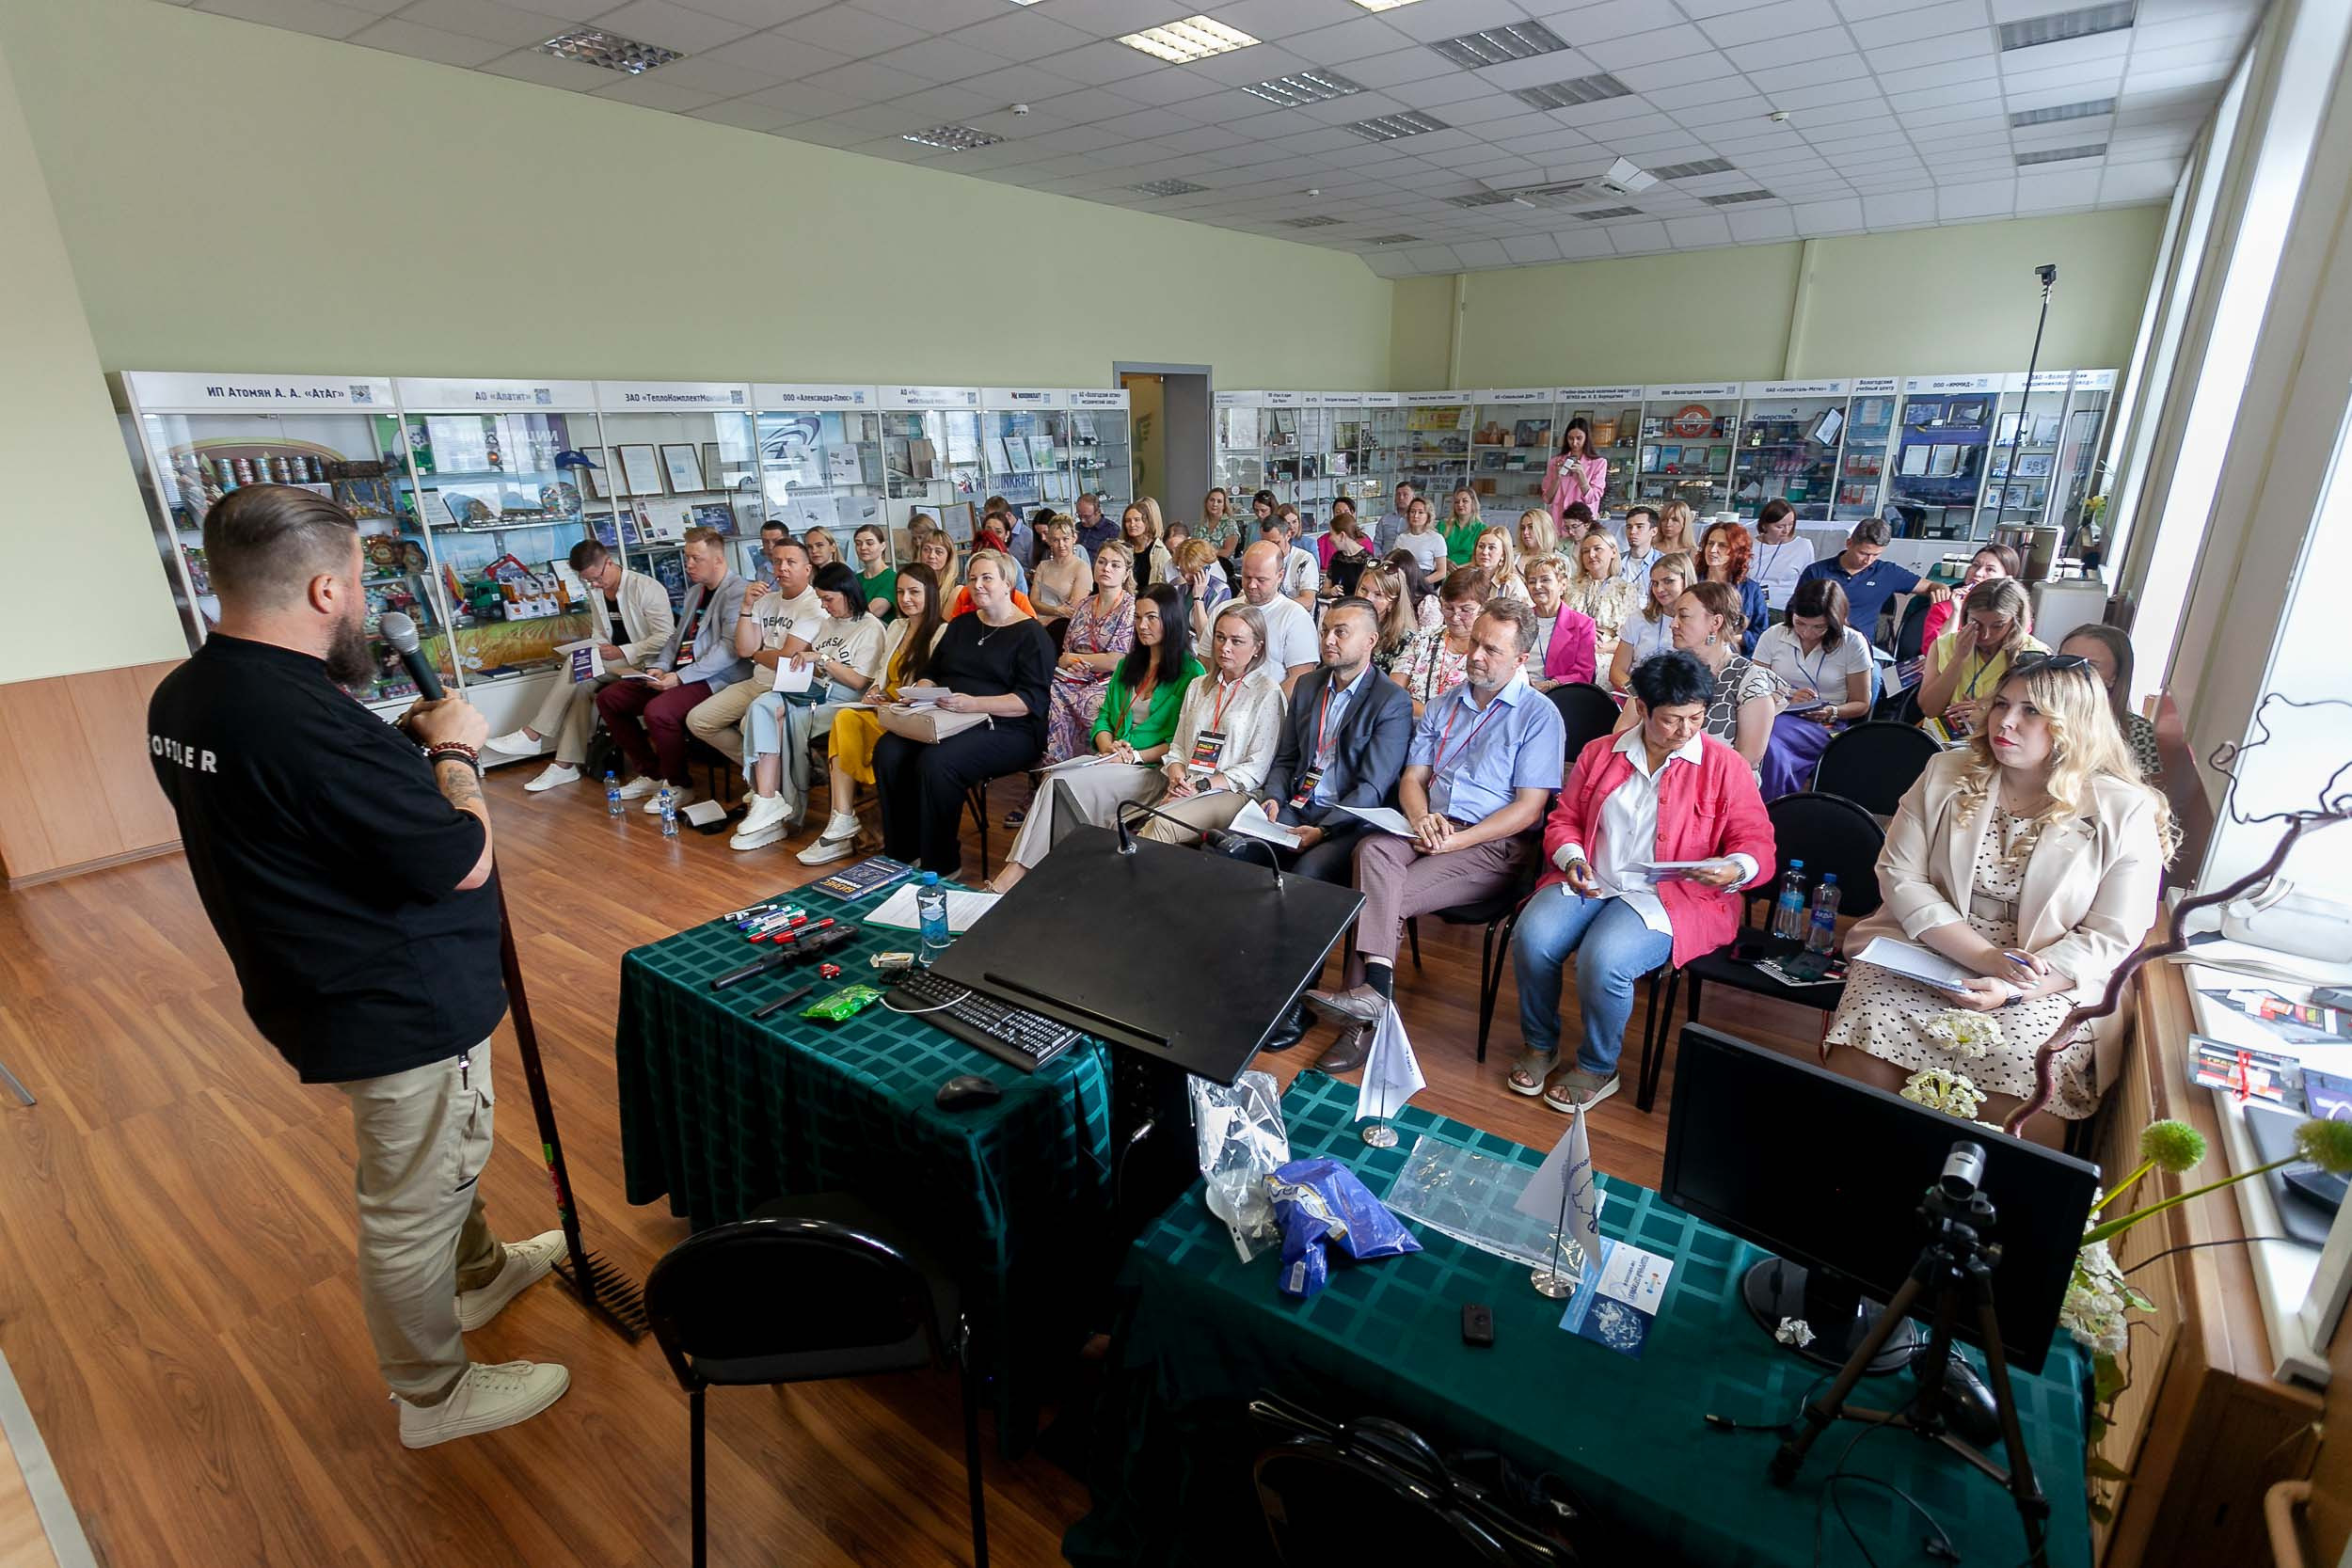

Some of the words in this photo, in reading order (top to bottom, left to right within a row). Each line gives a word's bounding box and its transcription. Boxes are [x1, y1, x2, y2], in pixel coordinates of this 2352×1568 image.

[206, 386, 225, 397] ИП
[228, 387, 272, 398] Атомян
[275, 388, 286, 398] А.
[290, 388, 301, 398] А.
[304, 388, 344, 399] «АтАг»
[475, 391, 487, 401] АО
[490, 391, 532, 401] «Апатит»
[625, 393, 640, 402] ЗАО
[783, 393, 795, 402] ООО
[1753, 413, 1793, 422] Северсталь
